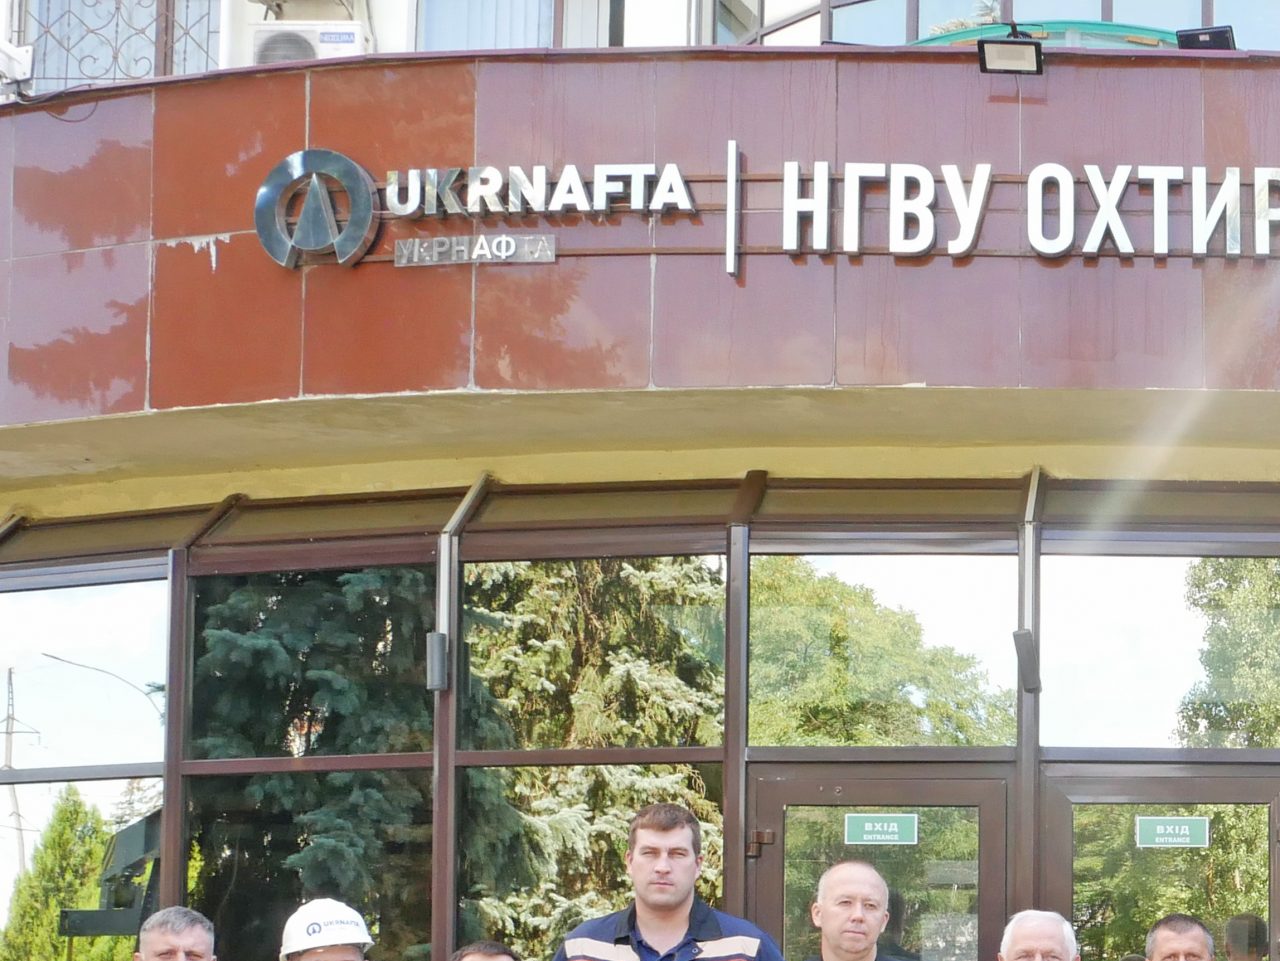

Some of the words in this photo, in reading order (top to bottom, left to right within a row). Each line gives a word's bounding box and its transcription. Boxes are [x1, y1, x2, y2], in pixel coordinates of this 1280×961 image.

[386, 163, 694, 218] UKRNAFTA
[782, 160, 992, 258] НГВУ
[864, 822, 899, 833] ВХІД
[1156, 825, 1190, 836] ВХІД
